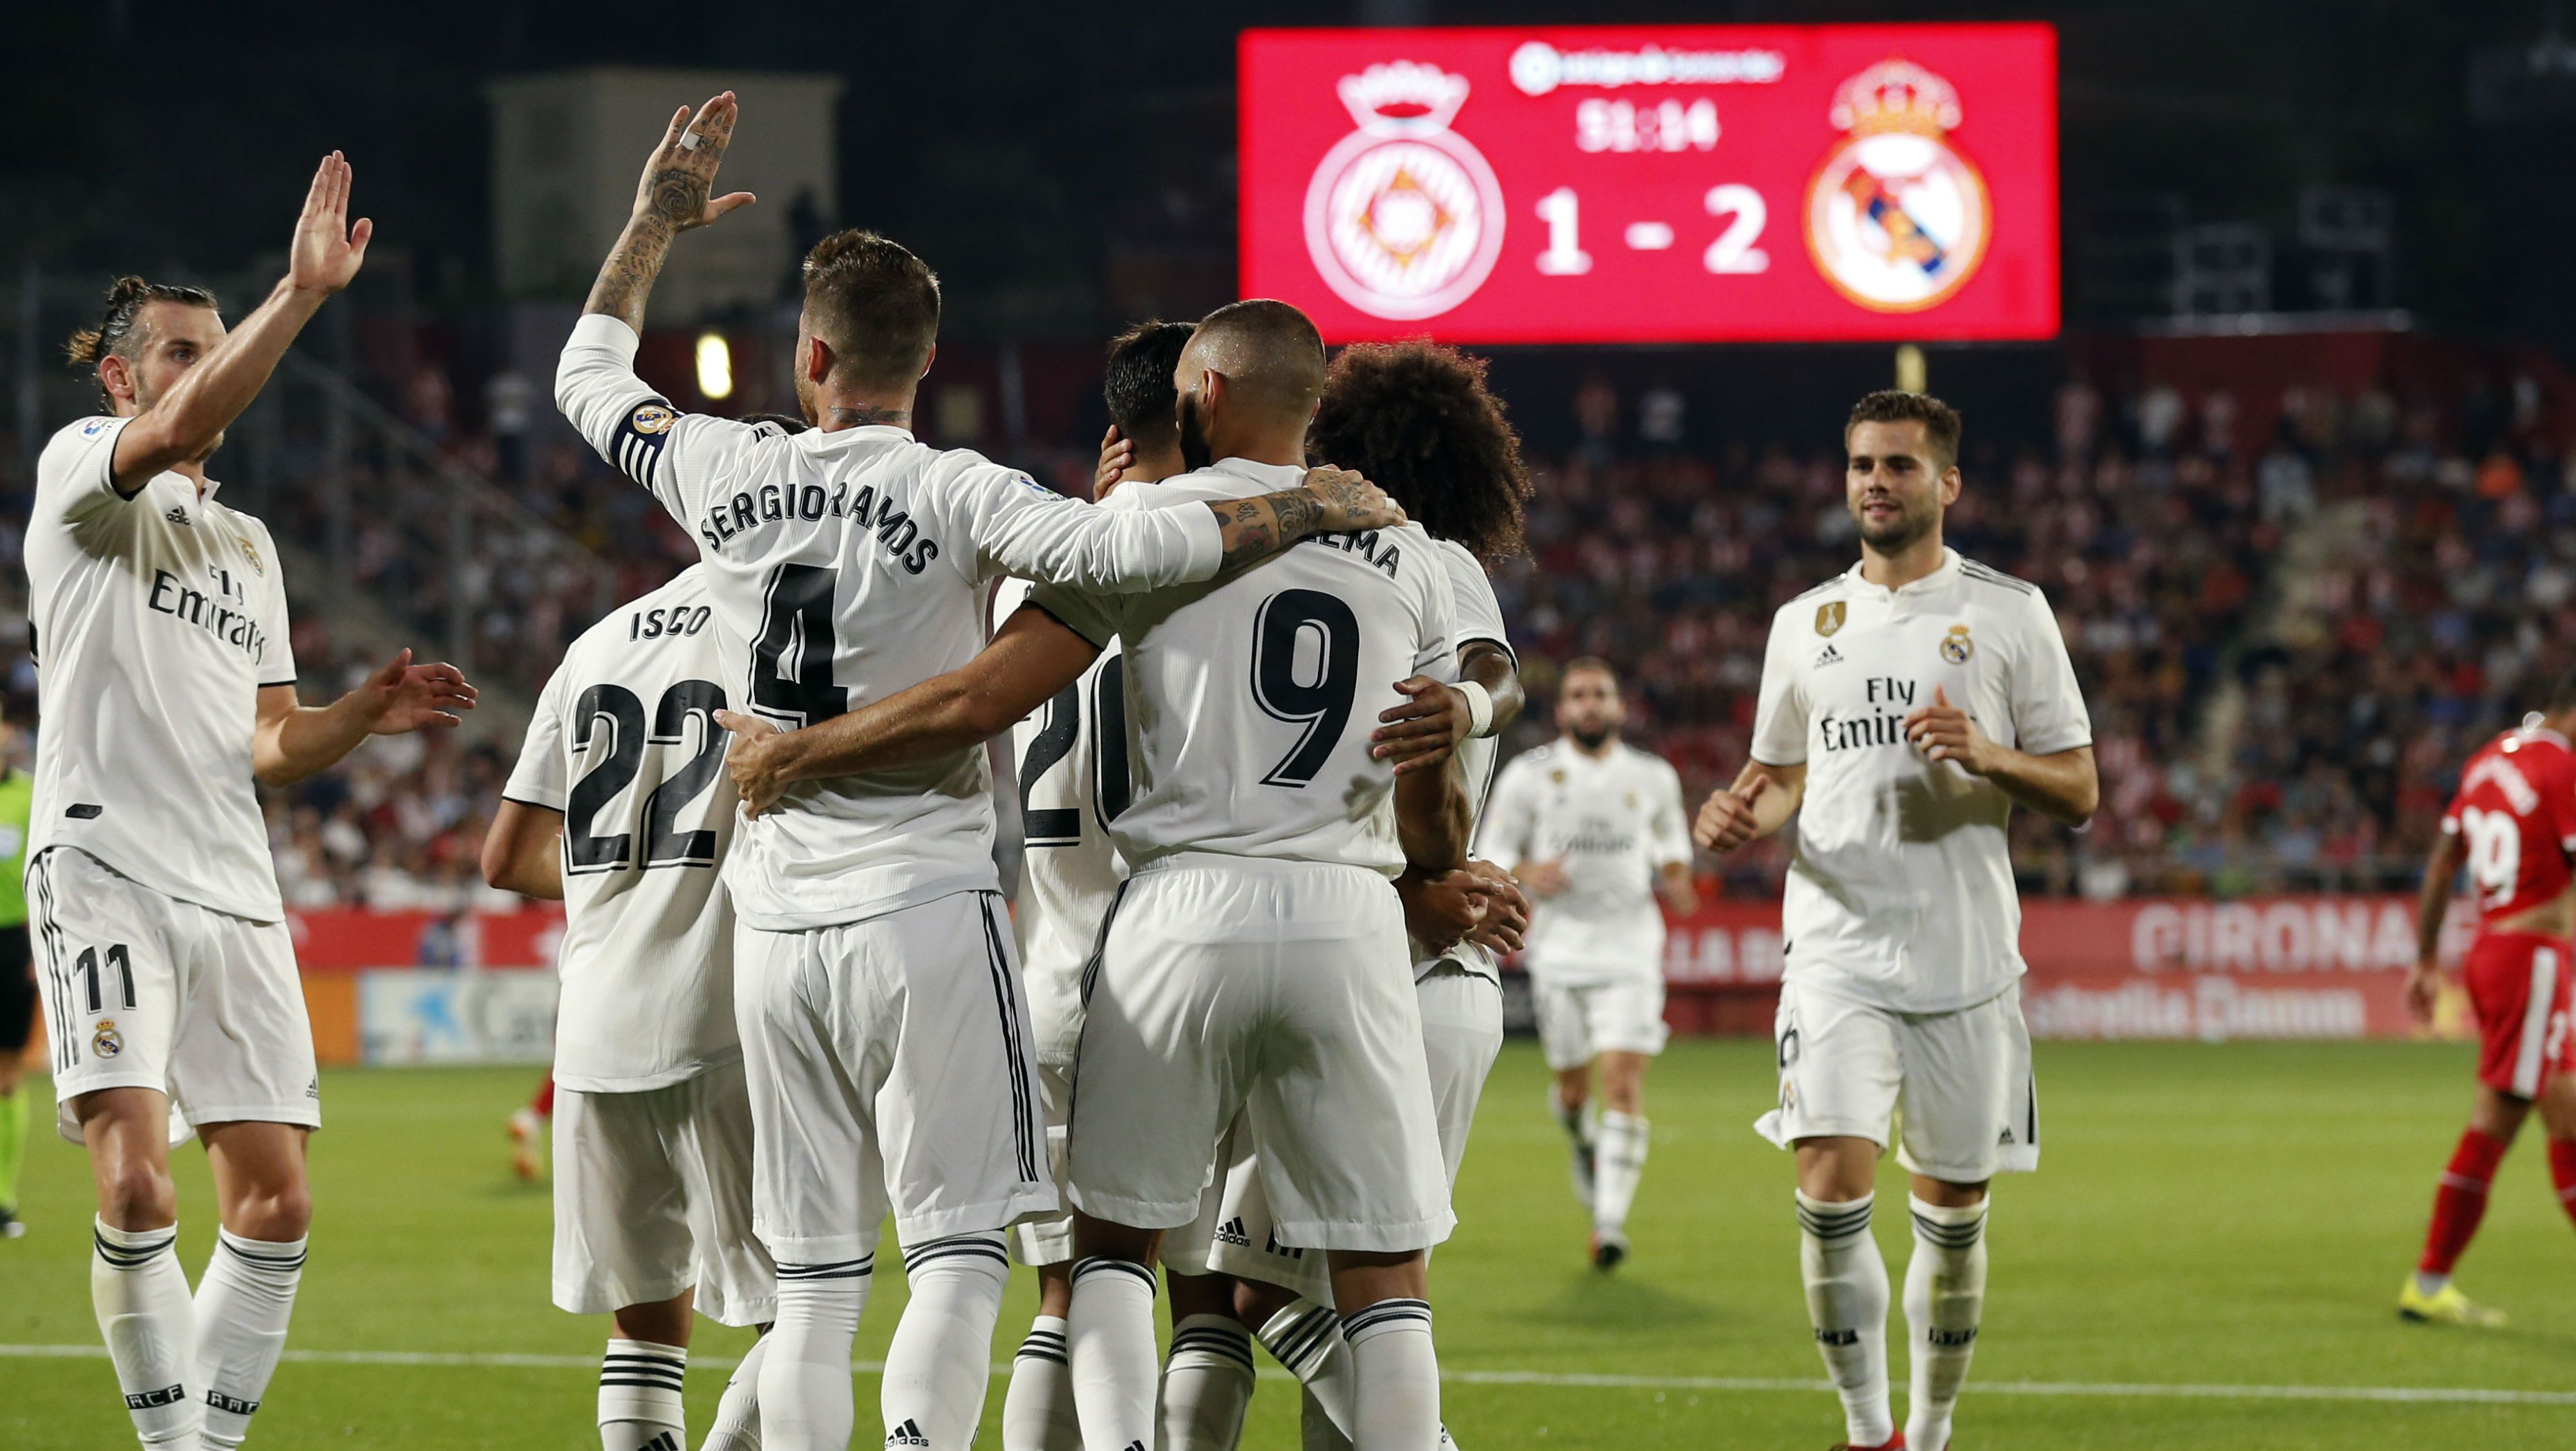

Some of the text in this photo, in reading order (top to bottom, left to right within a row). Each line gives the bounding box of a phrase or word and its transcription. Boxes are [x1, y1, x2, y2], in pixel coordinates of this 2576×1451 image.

[1536, 187, 1592, 276] 1
[1704, 184, 1770, 275] 2
[630, 605, 711, 643] ISCO
[747, 563, 849, 730] 4
[1250, 588, 1360, 789] 9
[1867, 676, 1915, 705] Fly
[563, 679, 731, 876] 22
[2131, 901, 2418, 973] GIRONA
[73, 944, 137, 1015] 11
